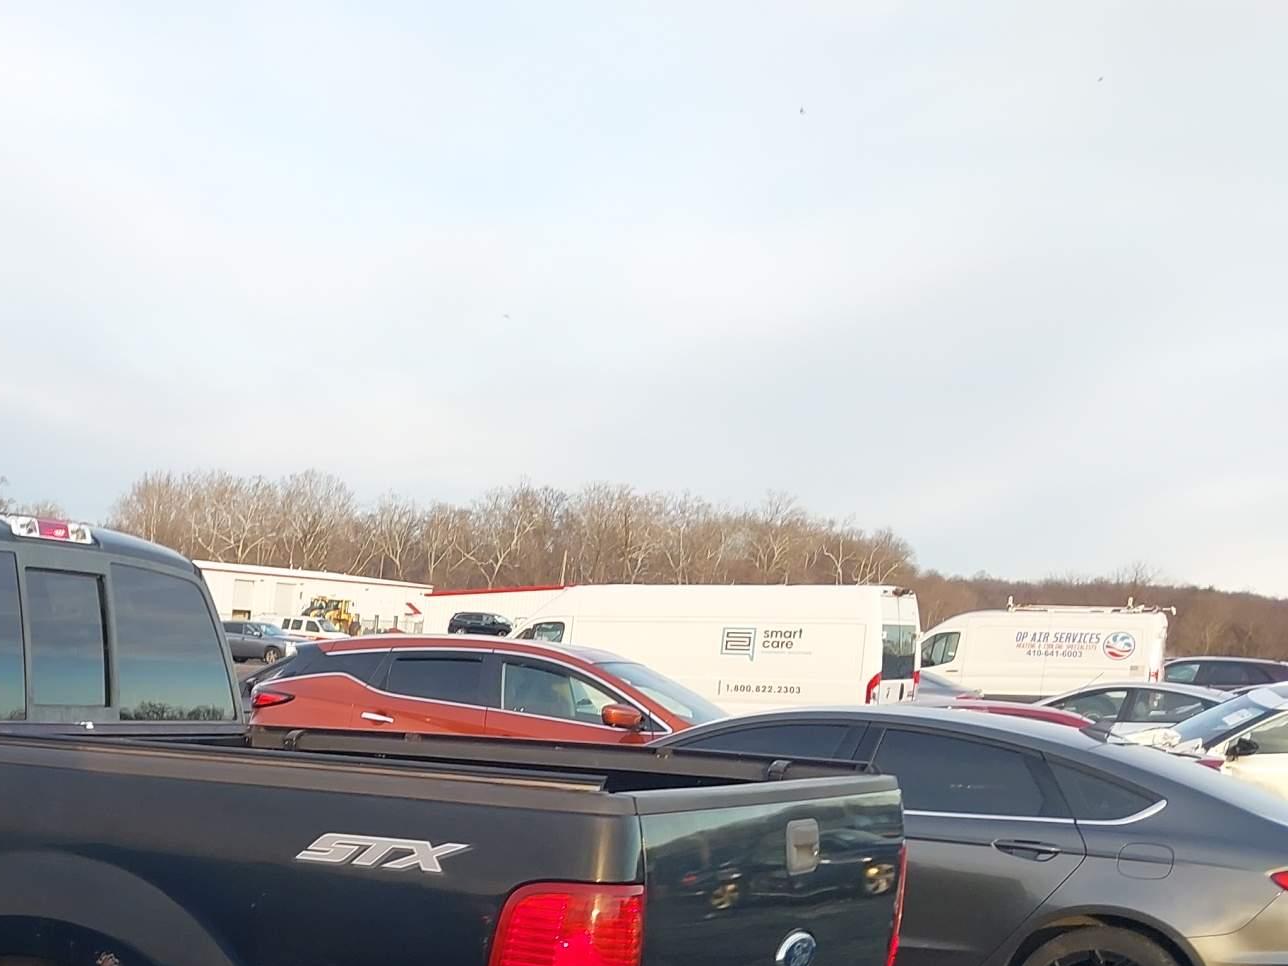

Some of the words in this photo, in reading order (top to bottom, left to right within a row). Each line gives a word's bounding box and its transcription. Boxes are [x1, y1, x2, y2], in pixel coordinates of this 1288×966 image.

[763, 628, 803, 639] smart
[1030, 631, 1050, 643] AIR
[1052, 631, 1102, 645] SERVICES
[762, 640, 794, 649] care
[295, 832, 472, 873] STX
